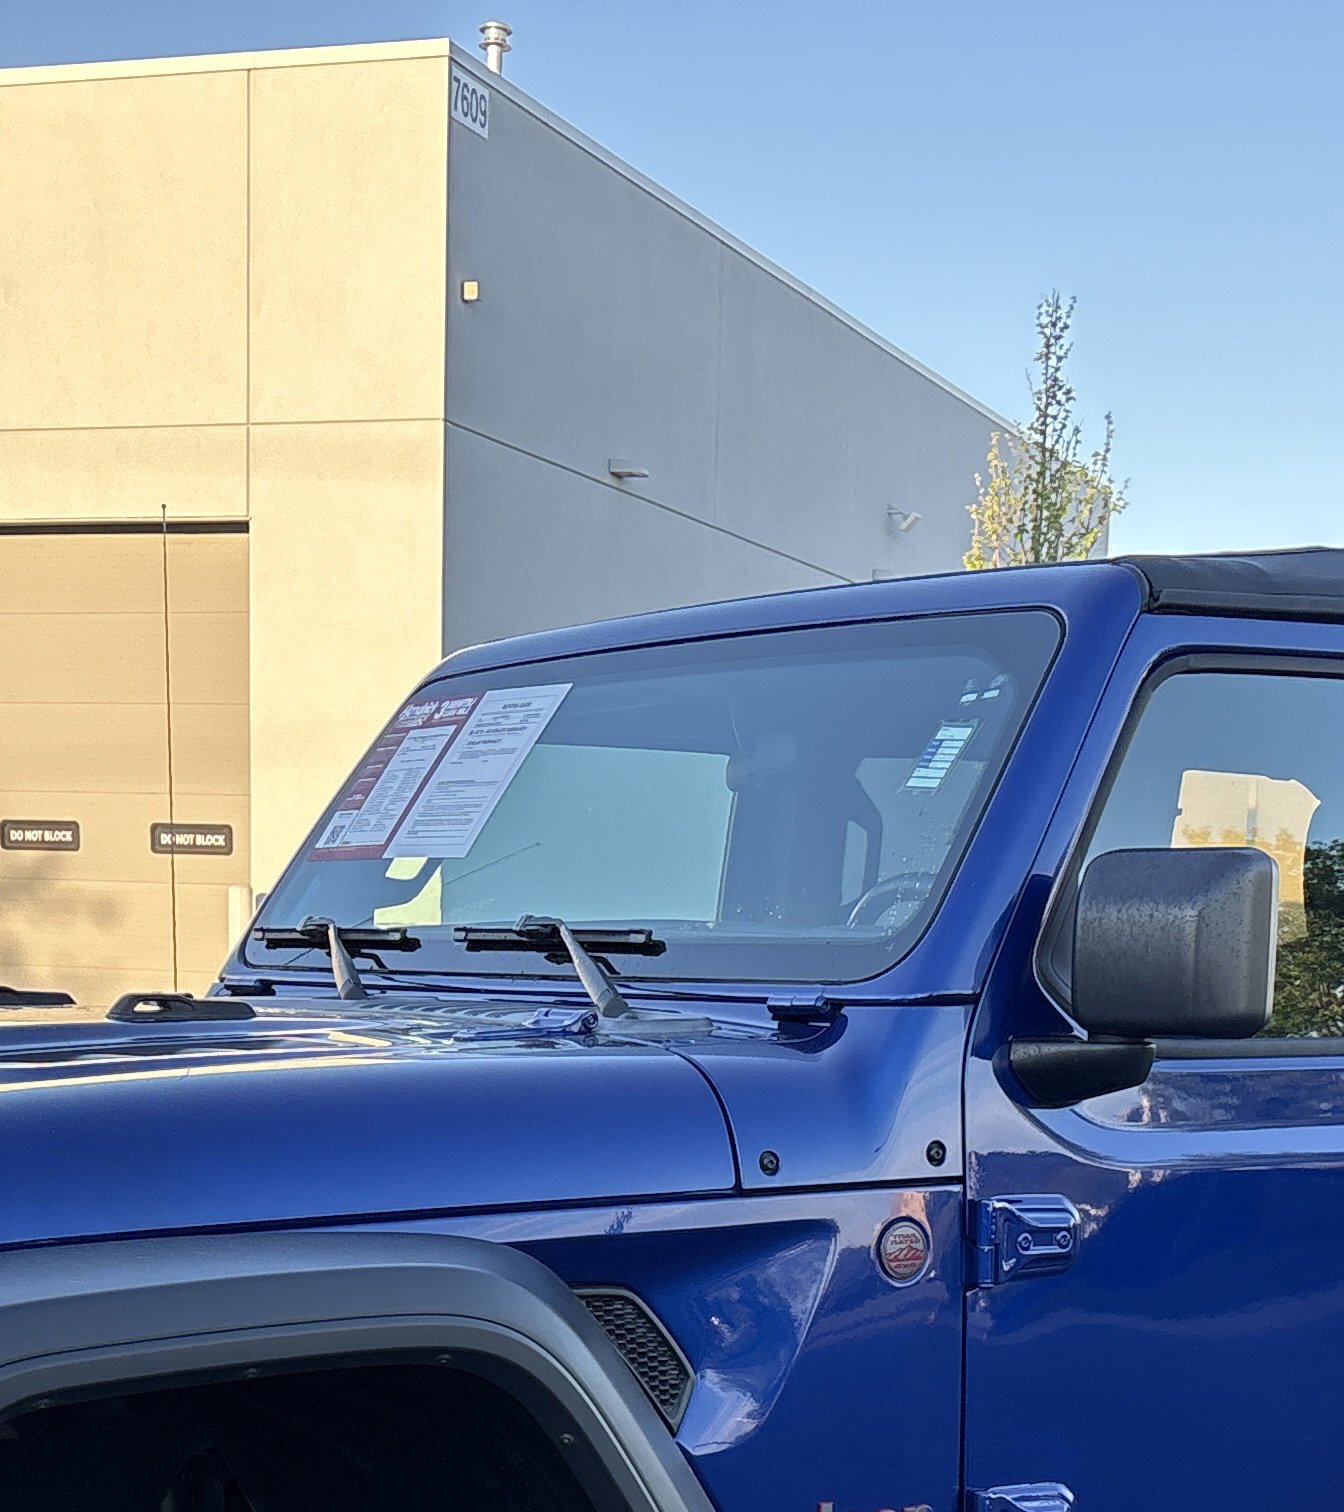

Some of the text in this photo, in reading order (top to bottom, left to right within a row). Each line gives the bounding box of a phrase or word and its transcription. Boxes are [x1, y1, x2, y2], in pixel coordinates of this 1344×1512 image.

[452, 74, 488, 129] 7609
[9, 829, 73, 842] DO NOT BLOCK
[175, 833, 195, 846] NOT
[195, 833, 226, 847] BLOCK
